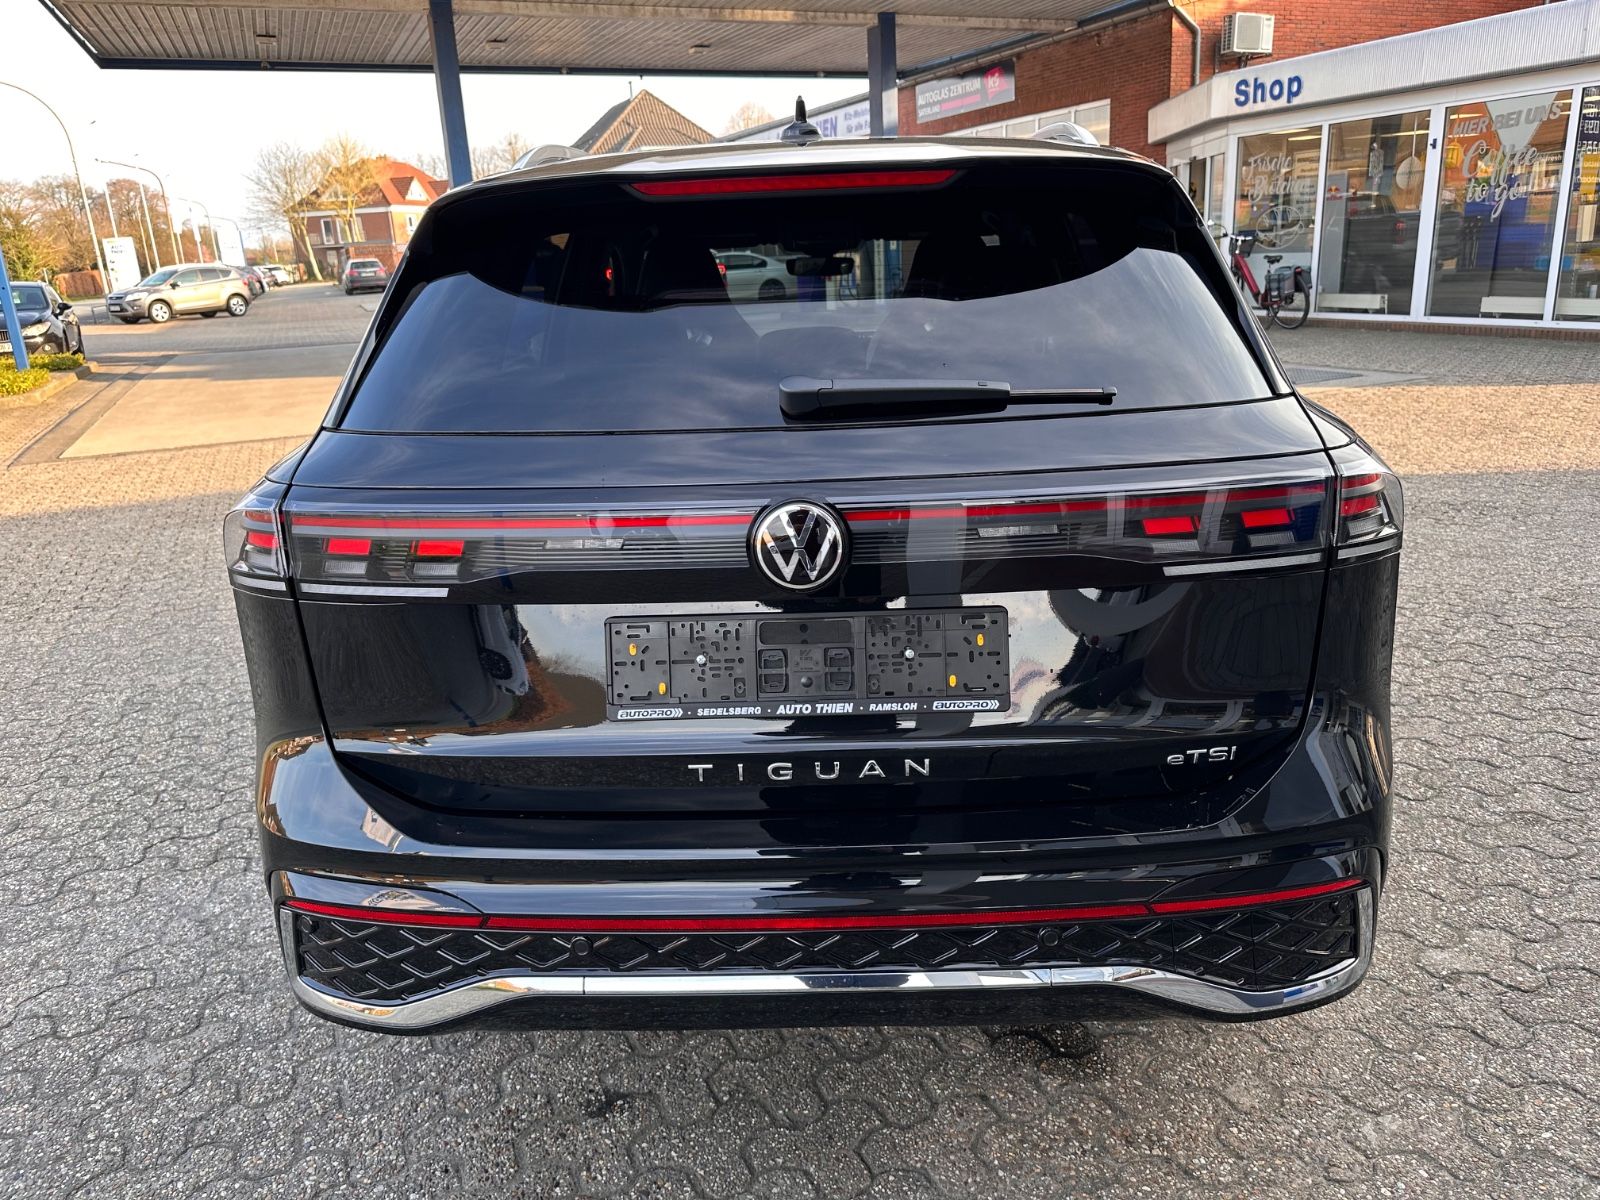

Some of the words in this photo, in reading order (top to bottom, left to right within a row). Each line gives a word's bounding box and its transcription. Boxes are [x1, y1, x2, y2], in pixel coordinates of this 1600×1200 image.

[918, 87, 949, 106] AUTOGLAS
[950, 77, 981, 97] ZENTRUM
[1234, 75, 1302, 107] Shop
[1453, 117, 1489, 135] HIER
[1495, 110, 1523, 129] BEI
[1524, 102, 1563, 124] UNS
[1463, 139, 1538, 185] Coffee
[1466, 178, 1488, 203] to
[697, 707, 762, 716] SEDELSBERG
[776, 704, 812, 715] AUTO
[816, 703, 854, 714] THIEN
[869, 702, 918, 712] RAMSLOH
[1166, 746, 1237, 765] eTSI
[688, 758, 930, 782] TIGUAN
